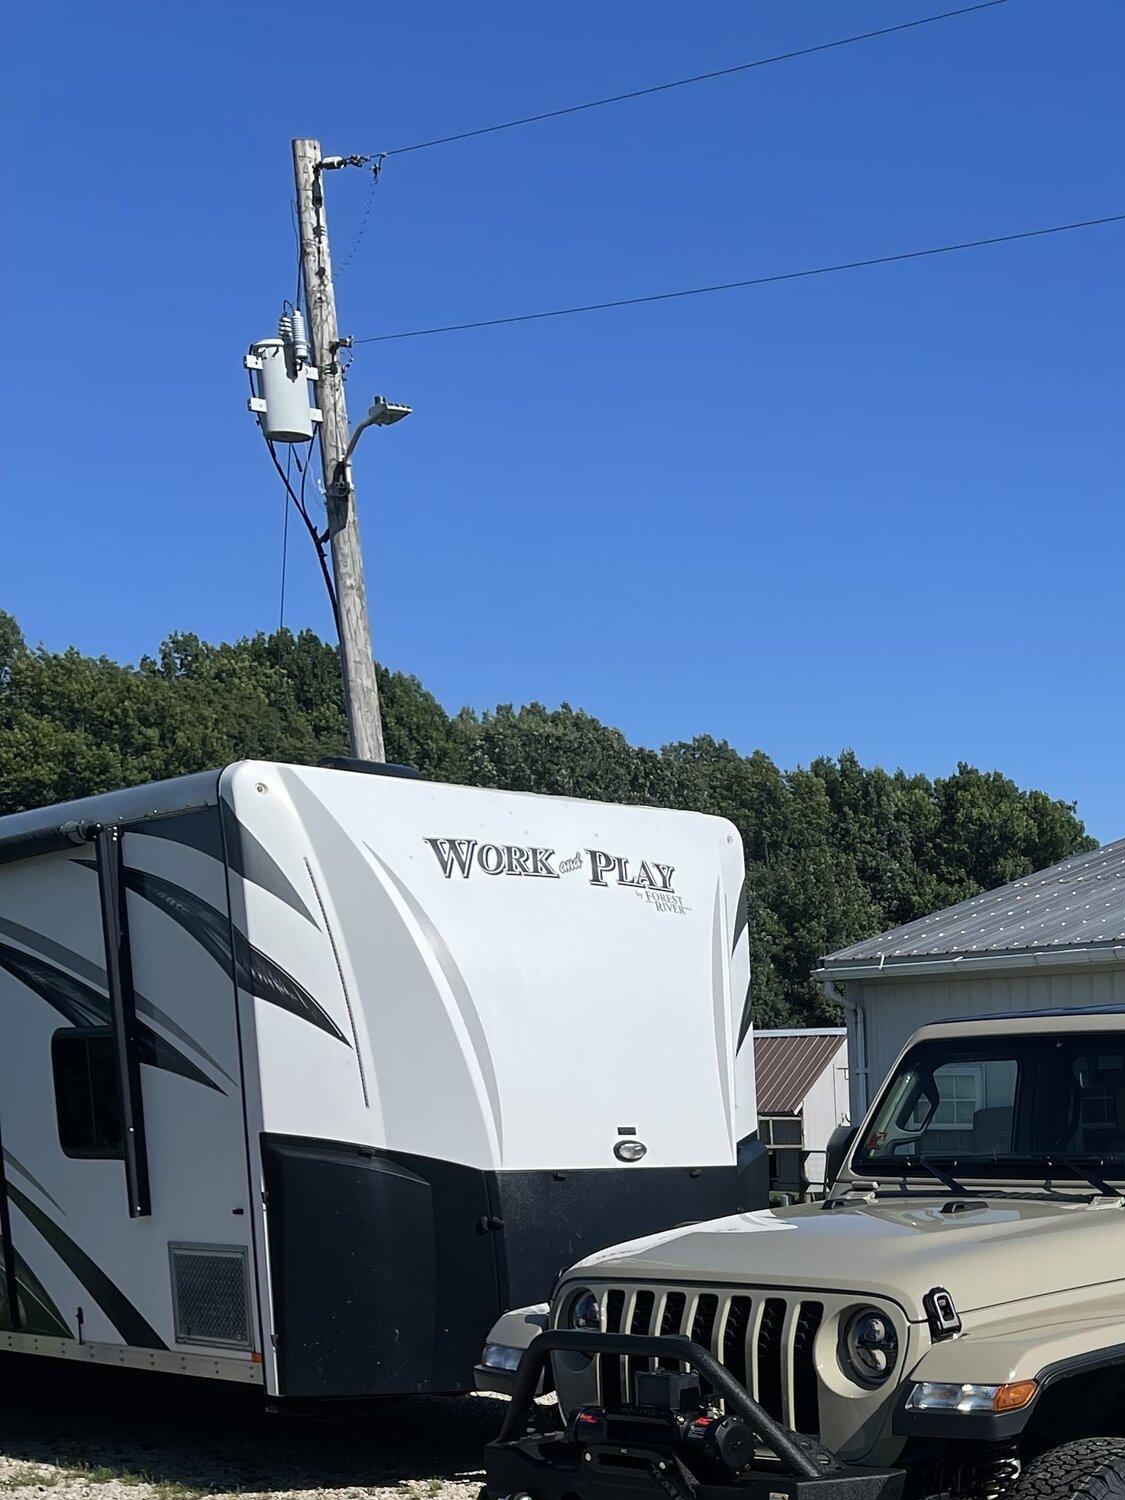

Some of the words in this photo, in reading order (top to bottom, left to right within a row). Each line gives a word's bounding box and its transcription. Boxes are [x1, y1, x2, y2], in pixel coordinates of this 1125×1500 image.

[422, 836, 560, 879] WORK
[559, 851, 583, 875] and
[585, 848, 675, 893] PLAY
[644, 890, 683, 906] FOREST
[654, 901, 687, 916] RIVER
